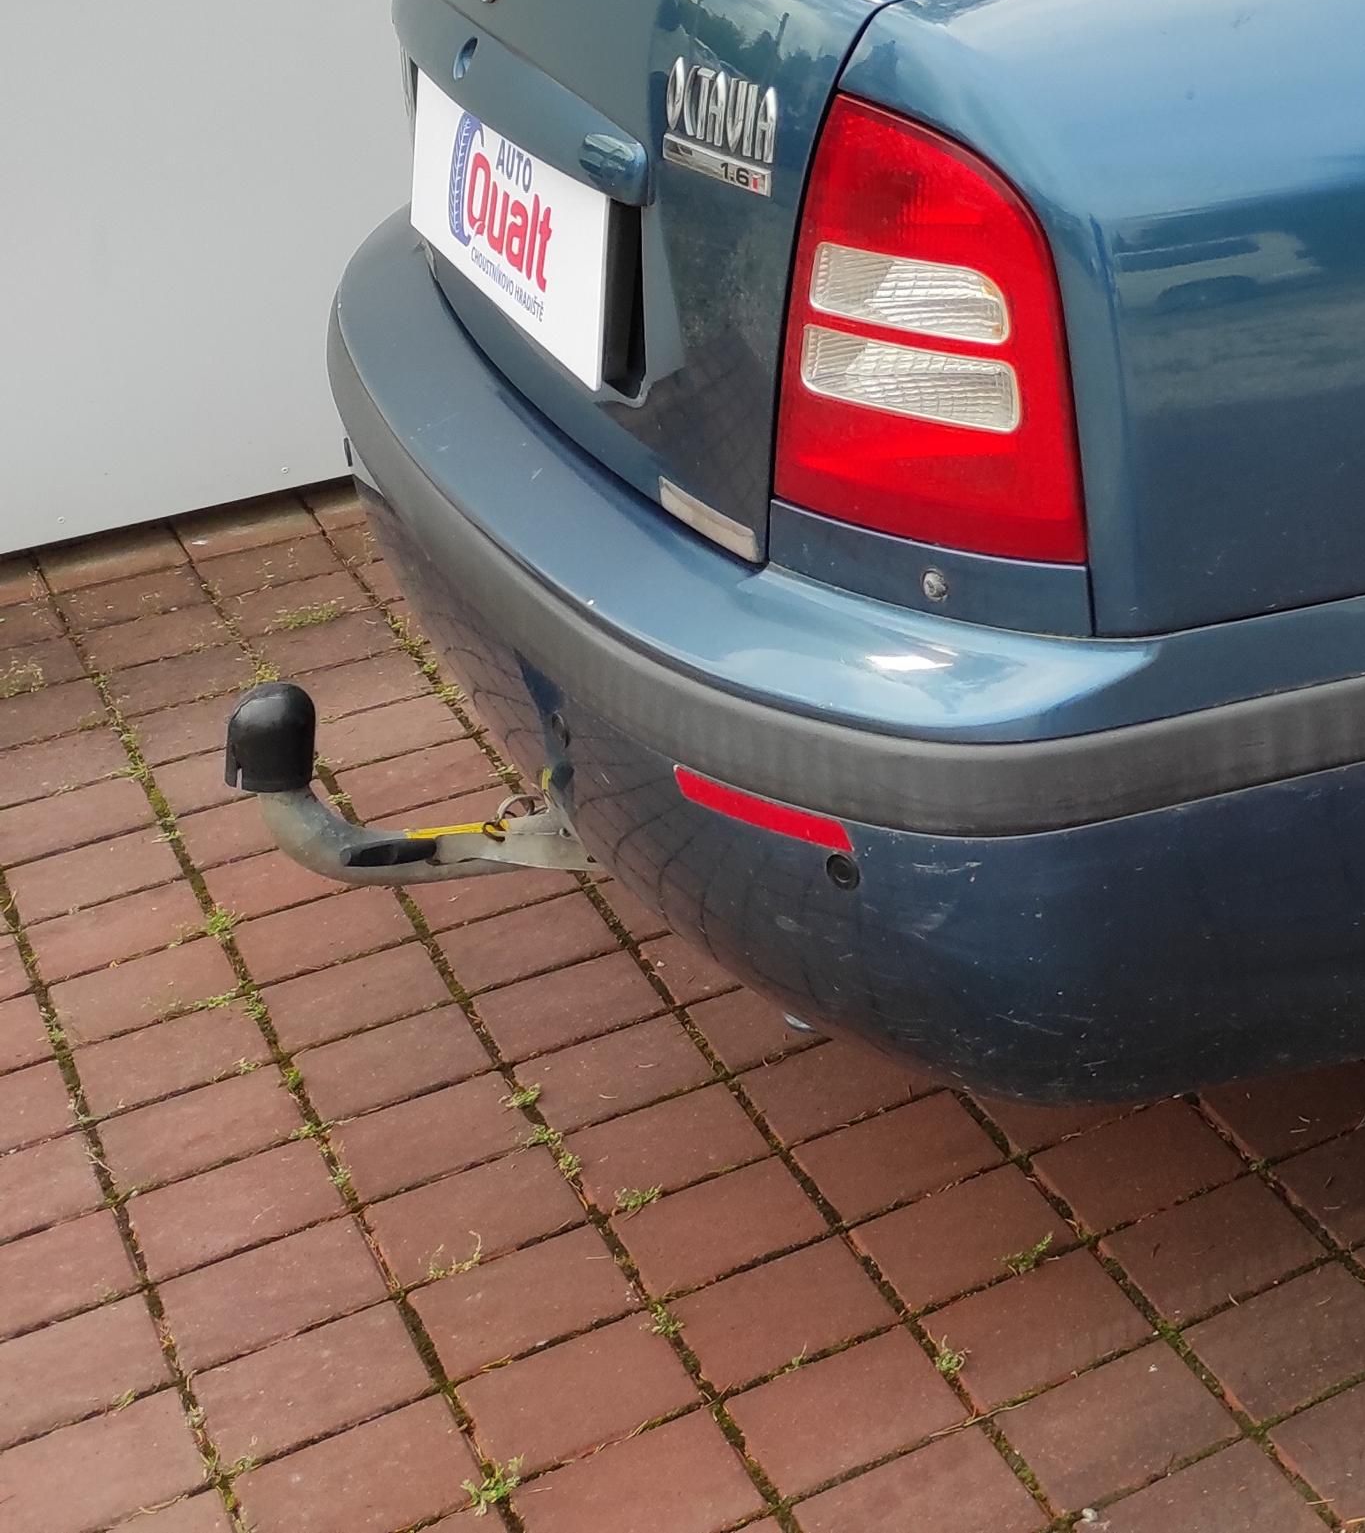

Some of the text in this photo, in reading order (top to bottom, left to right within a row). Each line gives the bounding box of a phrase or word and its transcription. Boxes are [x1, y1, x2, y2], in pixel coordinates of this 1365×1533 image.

[666, 55, 780, 164] OCTAVIA
[495, 139, 533, 193] AUTO
[467, 152, 553, 293] Qualt
[470, 246, 515, 297] CHOUSTNÍKOVO
